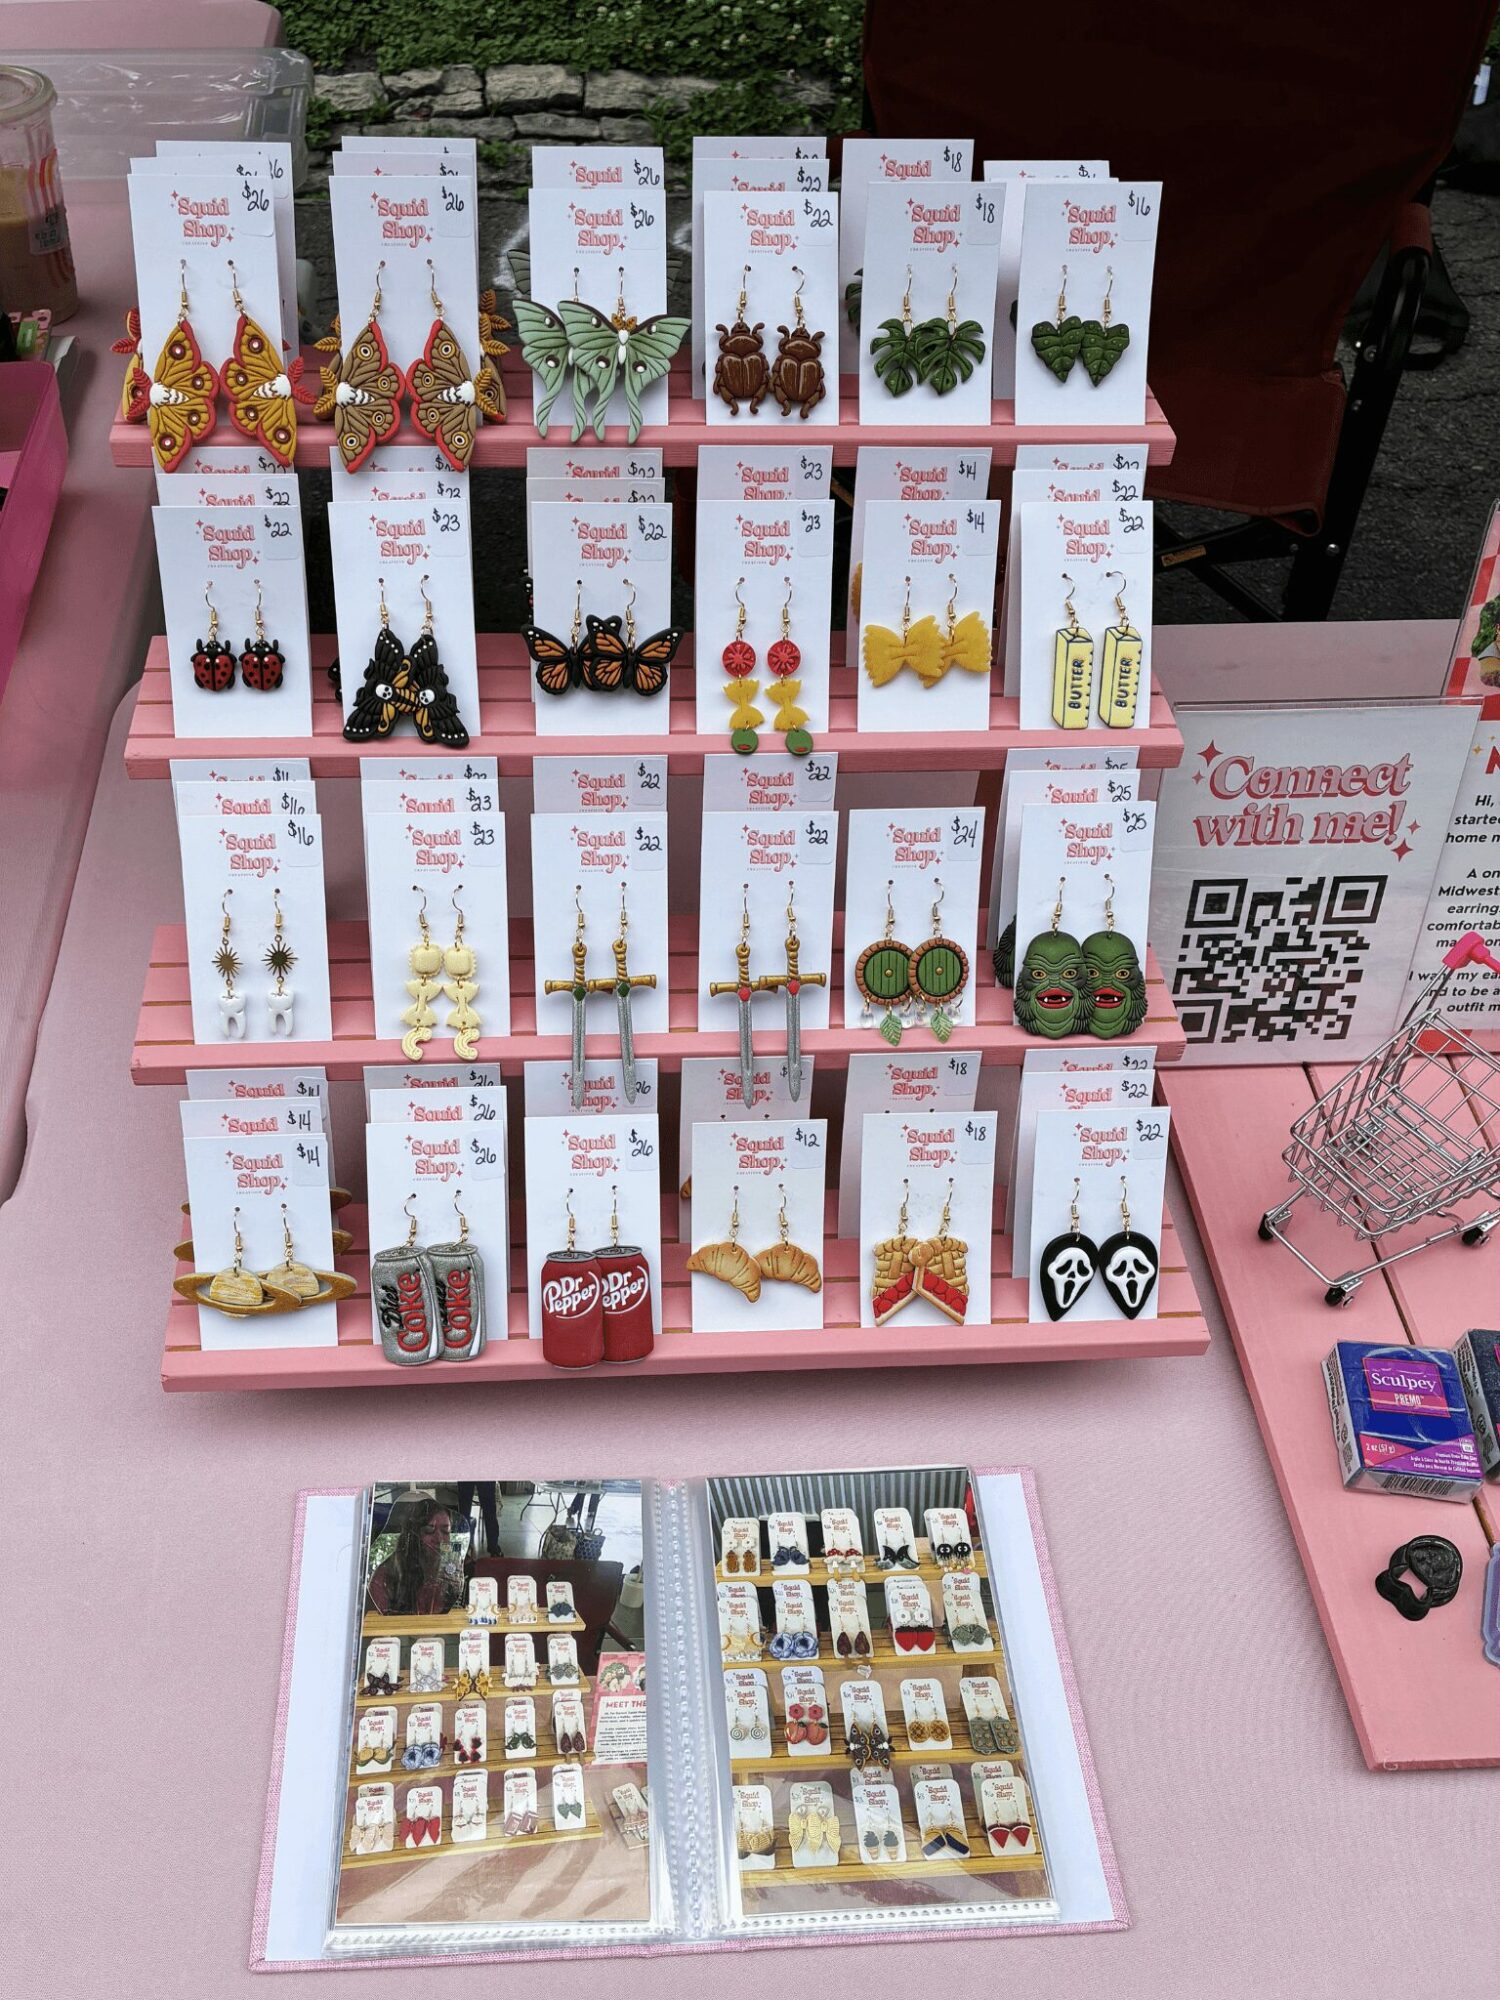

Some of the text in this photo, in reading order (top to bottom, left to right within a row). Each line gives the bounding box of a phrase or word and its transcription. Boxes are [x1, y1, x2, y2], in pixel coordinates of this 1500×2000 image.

[885, 160, 932, 179] Squid
[944, 146, 962, 172] $18
[576, 166, 622, 186] Squid
[634, 159, 660, 185] $26
[242, 180, 270, 212] $26
[441, 186, 464, 212] $26
[1128, 190, 1150, 216] $16
[178, 198, 230, 220] Squid
[378, 198, 429, 220] Squid
[574, 208, 623, 228] Squid
[630, 202, 654, 228] $26
[747, 209, 795, 229] Squid
[804, 199, 833, 228] $22
[912, 204, 960, 225] Squid
[976, 193, 995, 223] $18
[1068, 204, 1116, 225] Squid
[183, 220, 227, 247] Shop
[382, 221, 427, 248] Shop
[578, 230, 620, 255] Shop
[750, 230, 792, 255] Shop
[913, 226, 955, 252] Shop
[1069, 226, 1112, 253] Shop
[742, 466, 790, 486] Squid
[800, 456, 823, 480] $23
[900, 466, 948, 486] Squid
[958, 460, 977, 481] $14
[1112, 480, 1139, 501] $22
[264, 514, 292, 538] $22
[376, 519, 426, 539] Squid
[432, 508, 460, 532] $23
[638, 515, 667, 540] $22
[742, 520, 790, 540] Squid
[802, 510, 821, 532] $23
[908, 520, 957, 540] Squid
[966, 509, 985, 533] $14
[1063, 520, 1111, 540] Squid
[1119, 508, 1144, 533] $22
[203, 525, 256, 546] Squid
[578, 523, 628, 544] Squid
[208, 546, 252, 569] Shop
[380, 540, 423, 564] Shop
[581, 544, 625, 568] Shop
[744, 542, 786, 566] Shop
[911, 540, 952, 564] Shop
[1066, 540, 1108, 564] Shop
[1068, 658, 1084, 709] BUTTER
[1114, 657, 1132, 708] BUTTER
[638, 762, 660, 789] $22
[747, 772, 794, 790] Squid
[806, 760, 832, 781] $22
[1208, 752, 1414, 800] Connect
[578, 773, 626, 792] Squid
[1108, 780, 1132, 802] $25
[222, 798, 272, 815] Squid
[466, 788, 492, 812] $23
[581, 792, 622, 812] Shop
[750, 790, 790, 812] Shop
[1475, 795, 1494, 808] Hi,
[806, 820, 828, 844] $22
[952, 816, 978, 848] $24
[1064, 822, 1112, 842] Squid
[1123, 808, 1148, 834] $25
[1193, 800, 1408, 848] with me!
[226, 833, 276, 854] Squid
[288, 820, 314, 846] $16
[412, 830, 462, 850] Squid
[470, 822, 494, 846] $23
[576, 831, 626, 850] Squid
[635, 827, 663, 851] $22
[747, 830, 796, 849] Squid
[892, 826, 942, 846] Squid
[1446, 832, 1487, 844] home
[416, 850, 458, 873] Shop
[580, 851, 622, 874] Shop
[750, 850, 792, 872] Shop
[894, 846, 937, 870] Shop
[1066, 842, 1109, 866] Shop
[230, 854, 274, 878] Shop
[1466, 868, 1477, 878] A
[1438, 886, 1500, 896] Midwest
[1408, 971, 1478, 982] I my
[1452, 986, 1489, 996] to be
[1446, 1002, 1484, 1012] outfit
[891, 1066, 938, 1084] Squid
[949, 1058, 968, 1076] $18
[892, 1083, 934, 1100] Shop
[1065, 1088, 1112, 1106] Squid
[1121, 1081, 1149, 1098] $22
[414, 1104, 463, 1121] Squid
[470, 1095, 496, 1121] $26
[228, 1117, 278, 1135] Squid
[287, 1110, 312, 1130] $14
[965, 1121, 986, 1141] $18
[1136, 1120, 1164, 1142] $22
[568, 1134, 616, 1153] Squid
[629, 1129, 654, 1157] $26
[736, 1136, 784, 1156] Squid
[795, 1128, 820, 1148] $12
[906, 1128, 954, 1146] Squid
[1080, 1126, 1128, 1144] Squid
[296, 1142, 320, 1168] $14
[411, 1138, 461, 1159] Squid
[470, 1139, 496, 1165] $26
[909, 1147, 950, 1168] Shop
[1082, 1144, 1123, 1168] Shop
[232, 1154, 284, 1175] Squid
[416, 1158, 458, 1182] Shop
[572, 1154, 614, 1176] Shop
[738, 1155, 780, 1176] Shop
[237, 1174, 281, 1196] Shop
[560, 1276, 584, 1297] Dr
[608, 1272, 632, 1293] Dr
[543, 1280, 596, 1315] Pepper
[397, 1271, 430, 1352] Coke
[444, 1270, 472, 1348] Coke
[1372, 1372, 1437, 1392] Sculpey
